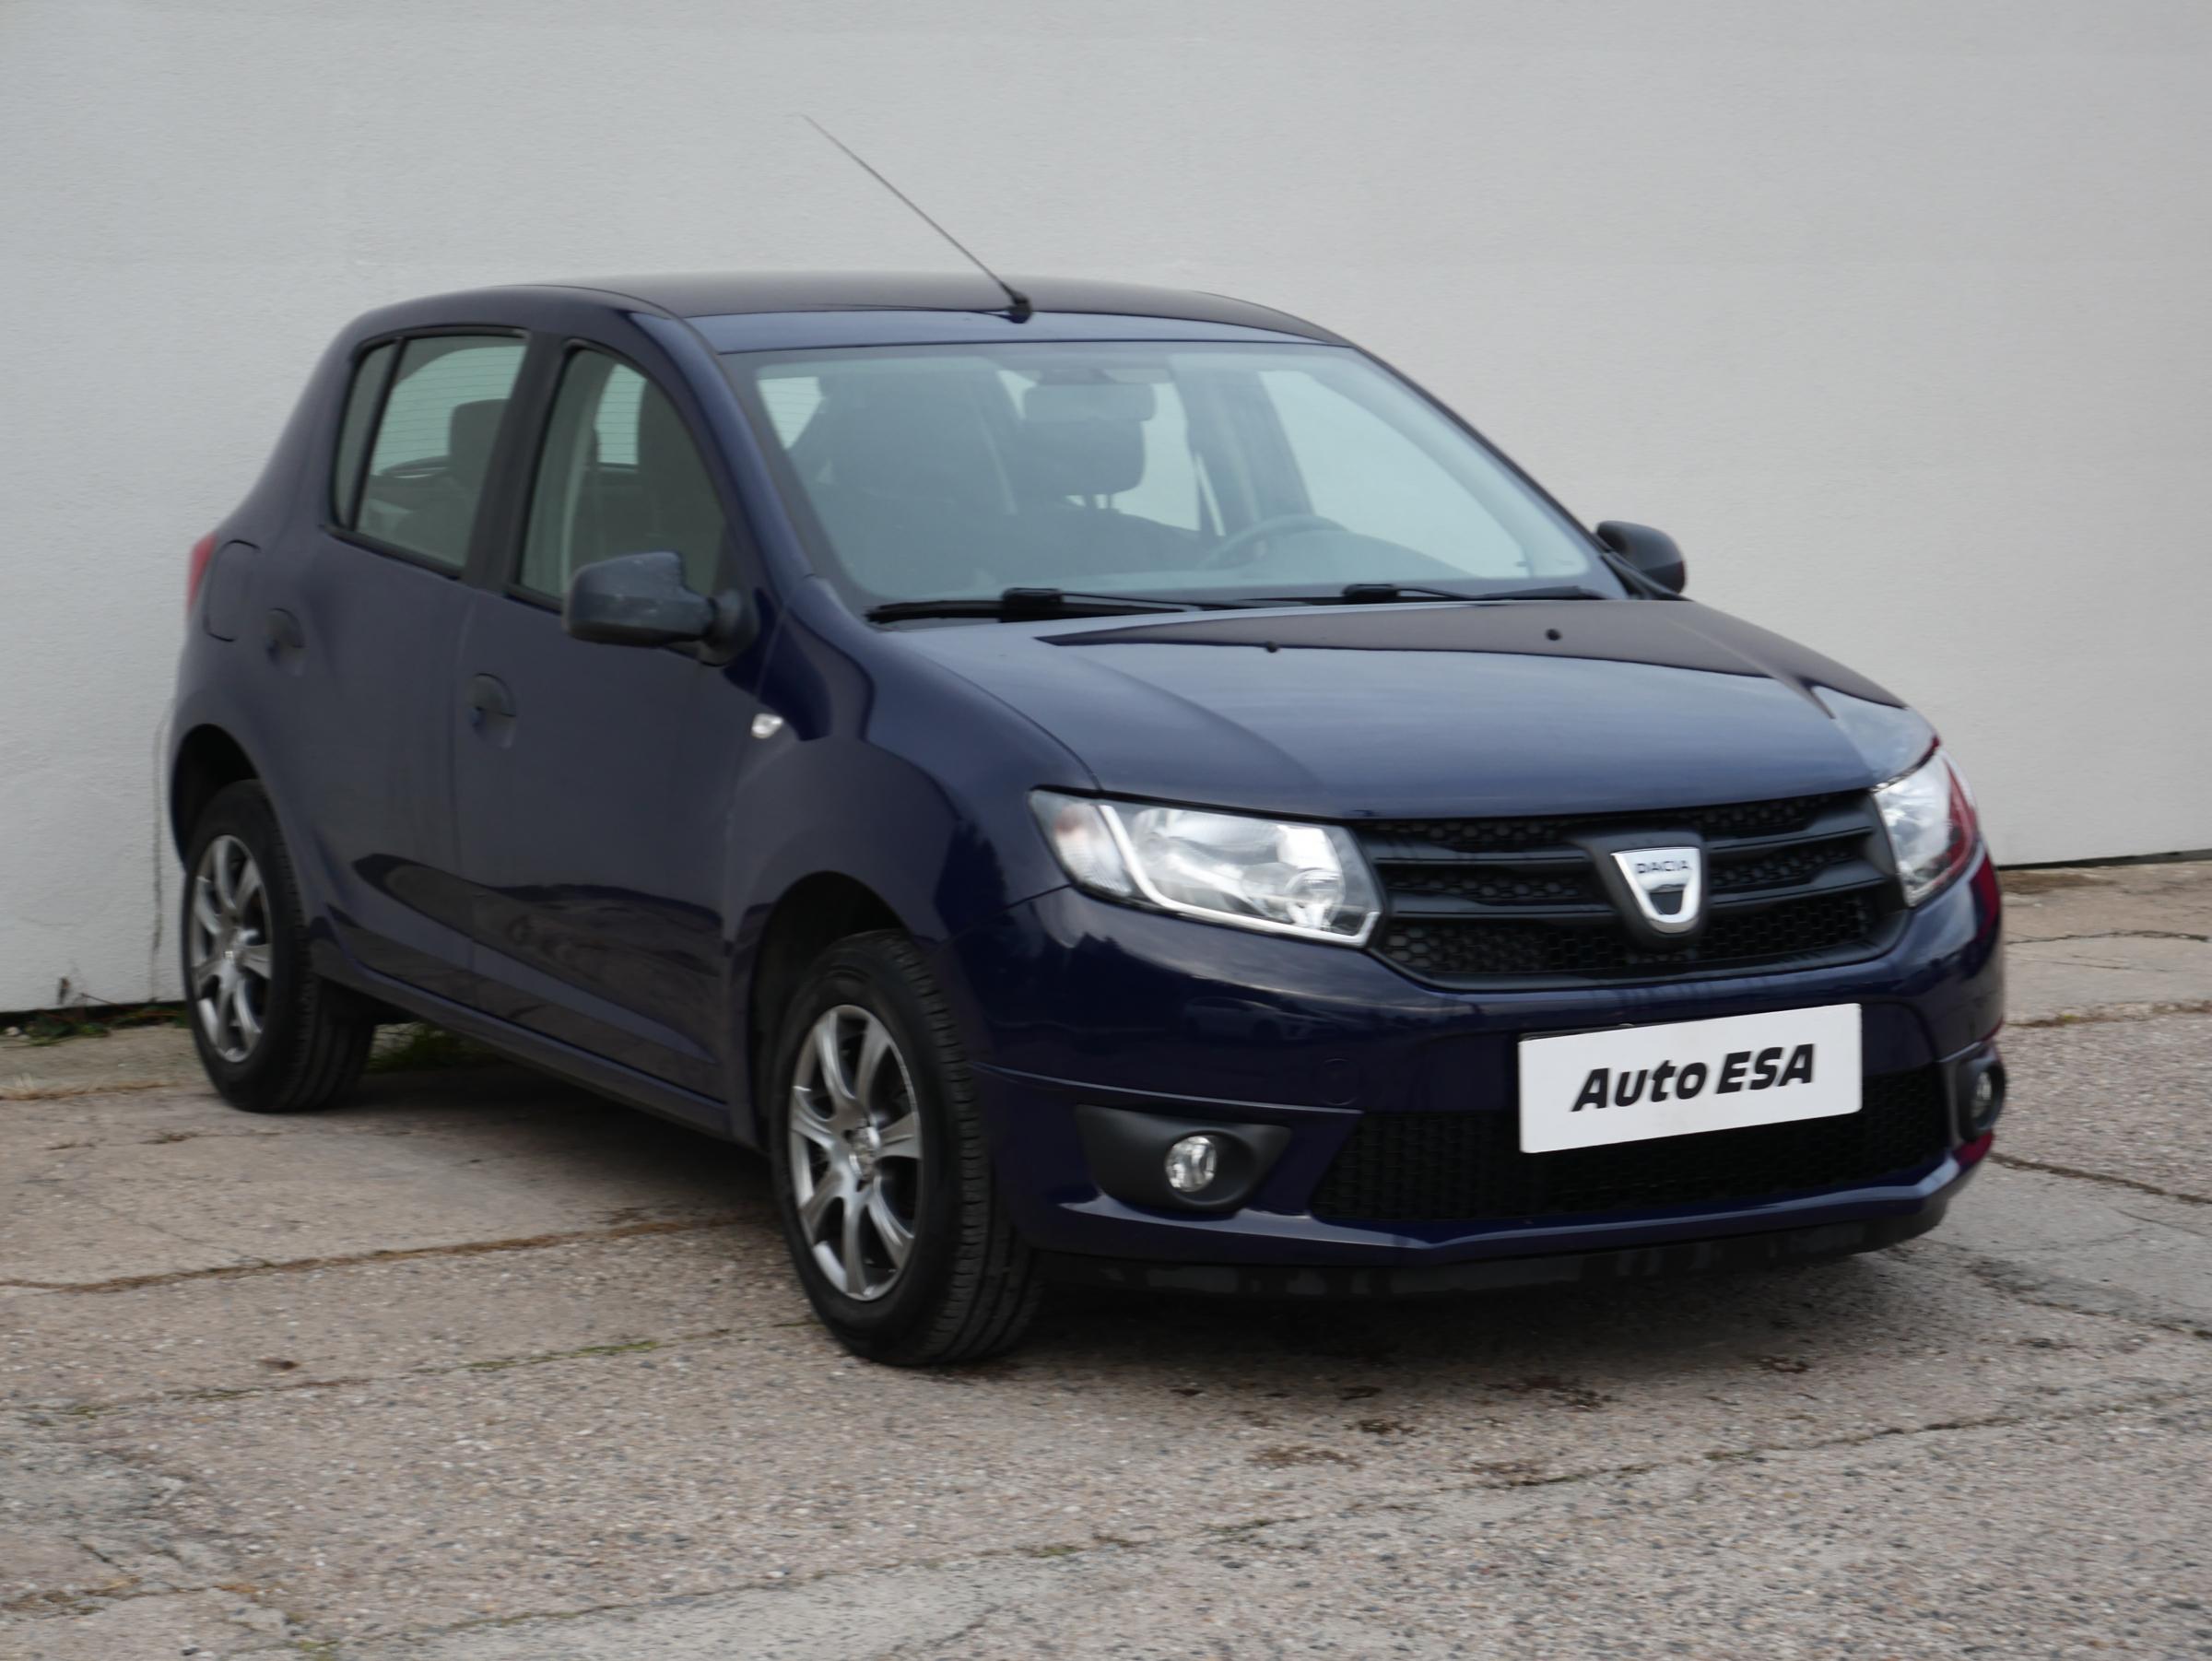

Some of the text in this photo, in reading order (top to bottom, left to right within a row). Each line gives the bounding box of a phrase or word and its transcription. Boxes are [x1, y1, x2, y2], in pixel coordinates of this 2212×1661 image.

[1635, 859, 1692, 875] DACIA
[1570, 1043, 1815, 1113] Auto ESA
